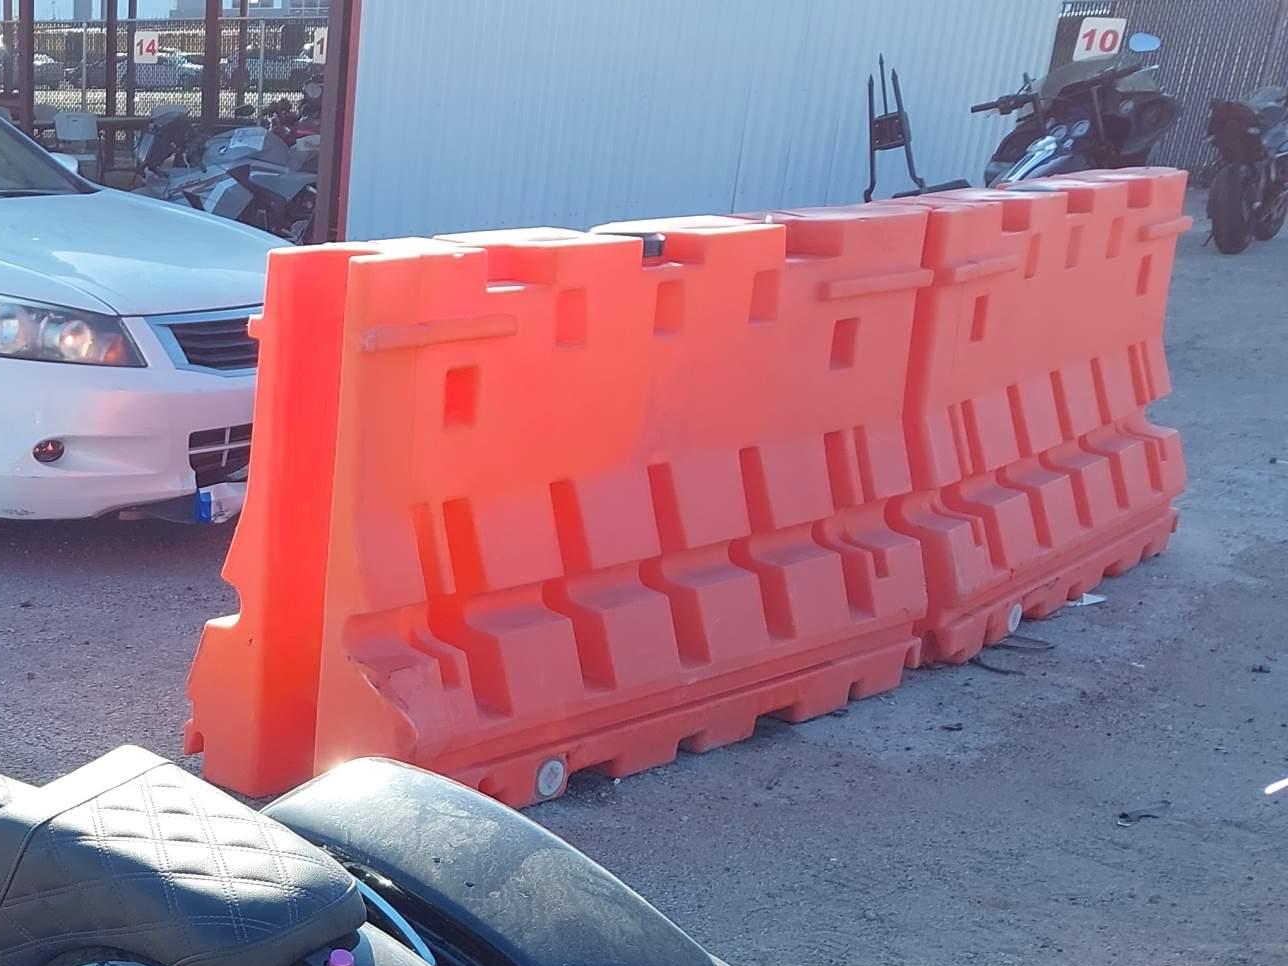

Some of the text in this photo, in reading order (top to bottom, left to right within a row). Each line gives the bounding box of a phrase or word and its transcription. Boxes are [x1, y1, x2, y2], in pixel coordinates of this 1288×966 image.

[135, 38, 157, 56] 14
[316, 37, 325, 55] 1
[1082, 28, 1119, 53] 10
